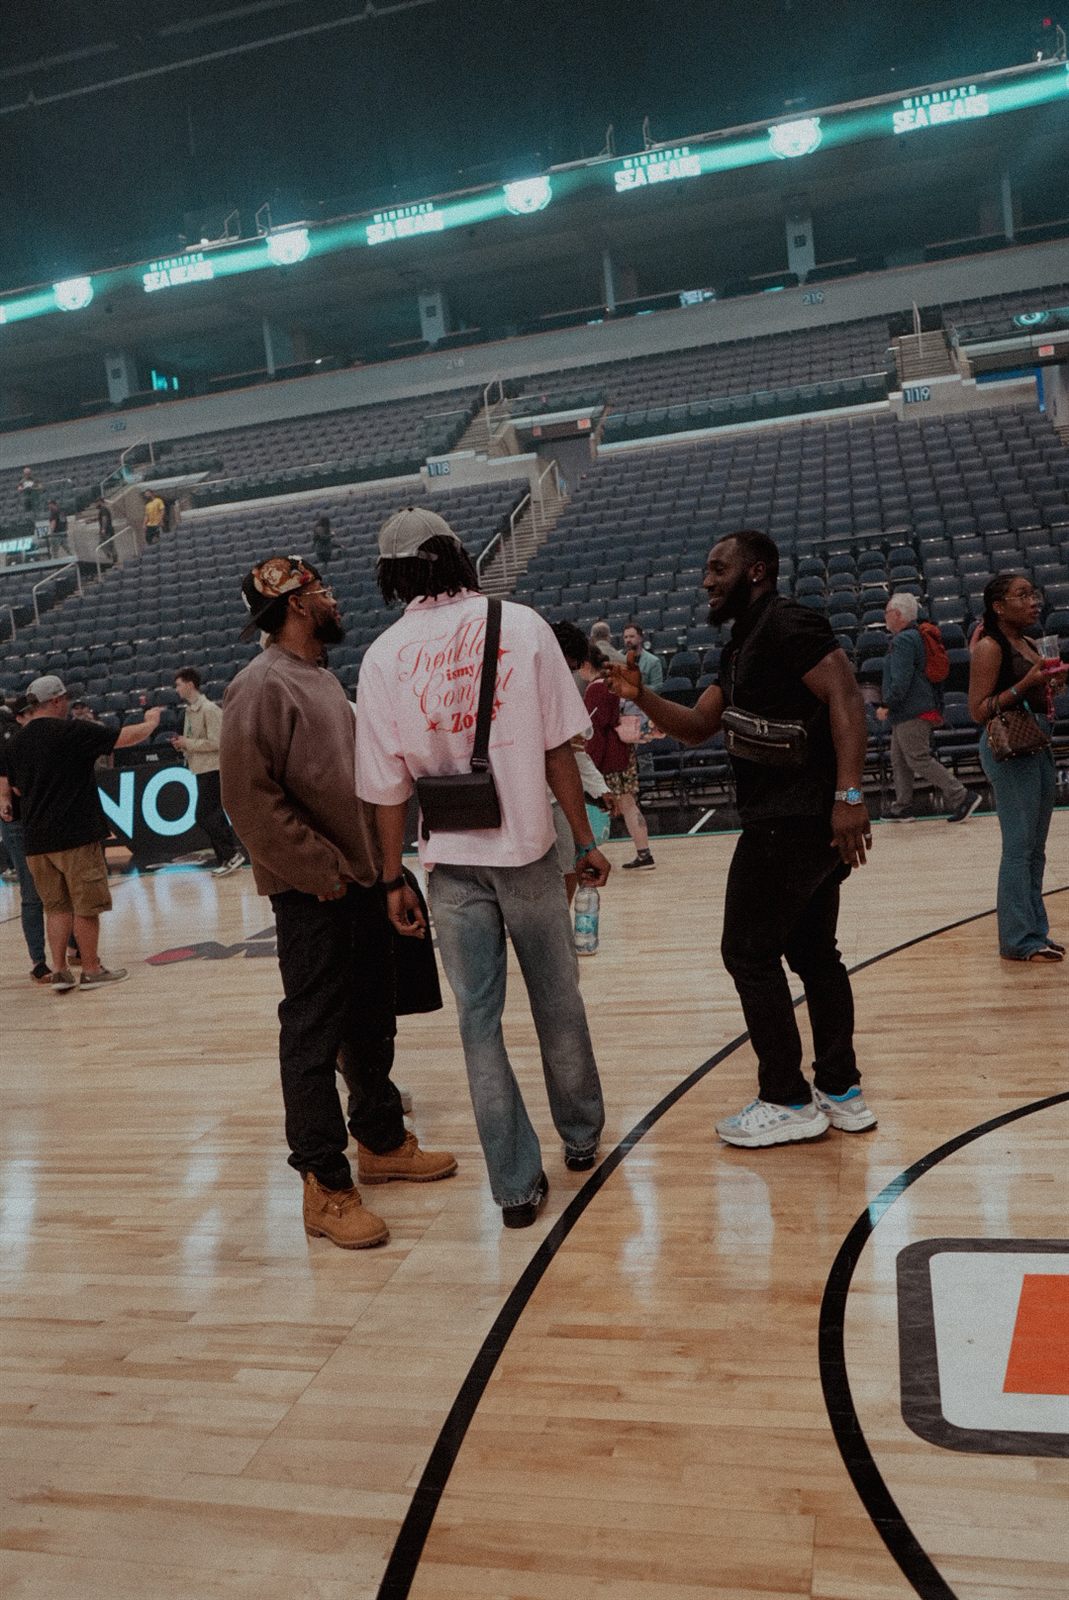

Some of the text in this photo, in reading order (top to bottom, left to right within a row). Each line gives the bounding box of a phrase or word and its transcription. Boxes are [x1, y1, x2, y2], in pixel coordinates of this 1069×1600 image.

[903, 85, 977, 109] WINNIPEG
[893, 94, 990, 134] SEA BEARS
[614, 154, 702, 192] SEA BEARS
[366, 221, 396, 245] SEA
[143, 270, 171, 292] SEA
[905, 386, 930, 402] 119
[429, 462, 449, 476] 118
[451, 708, 498, 734] Zoe
